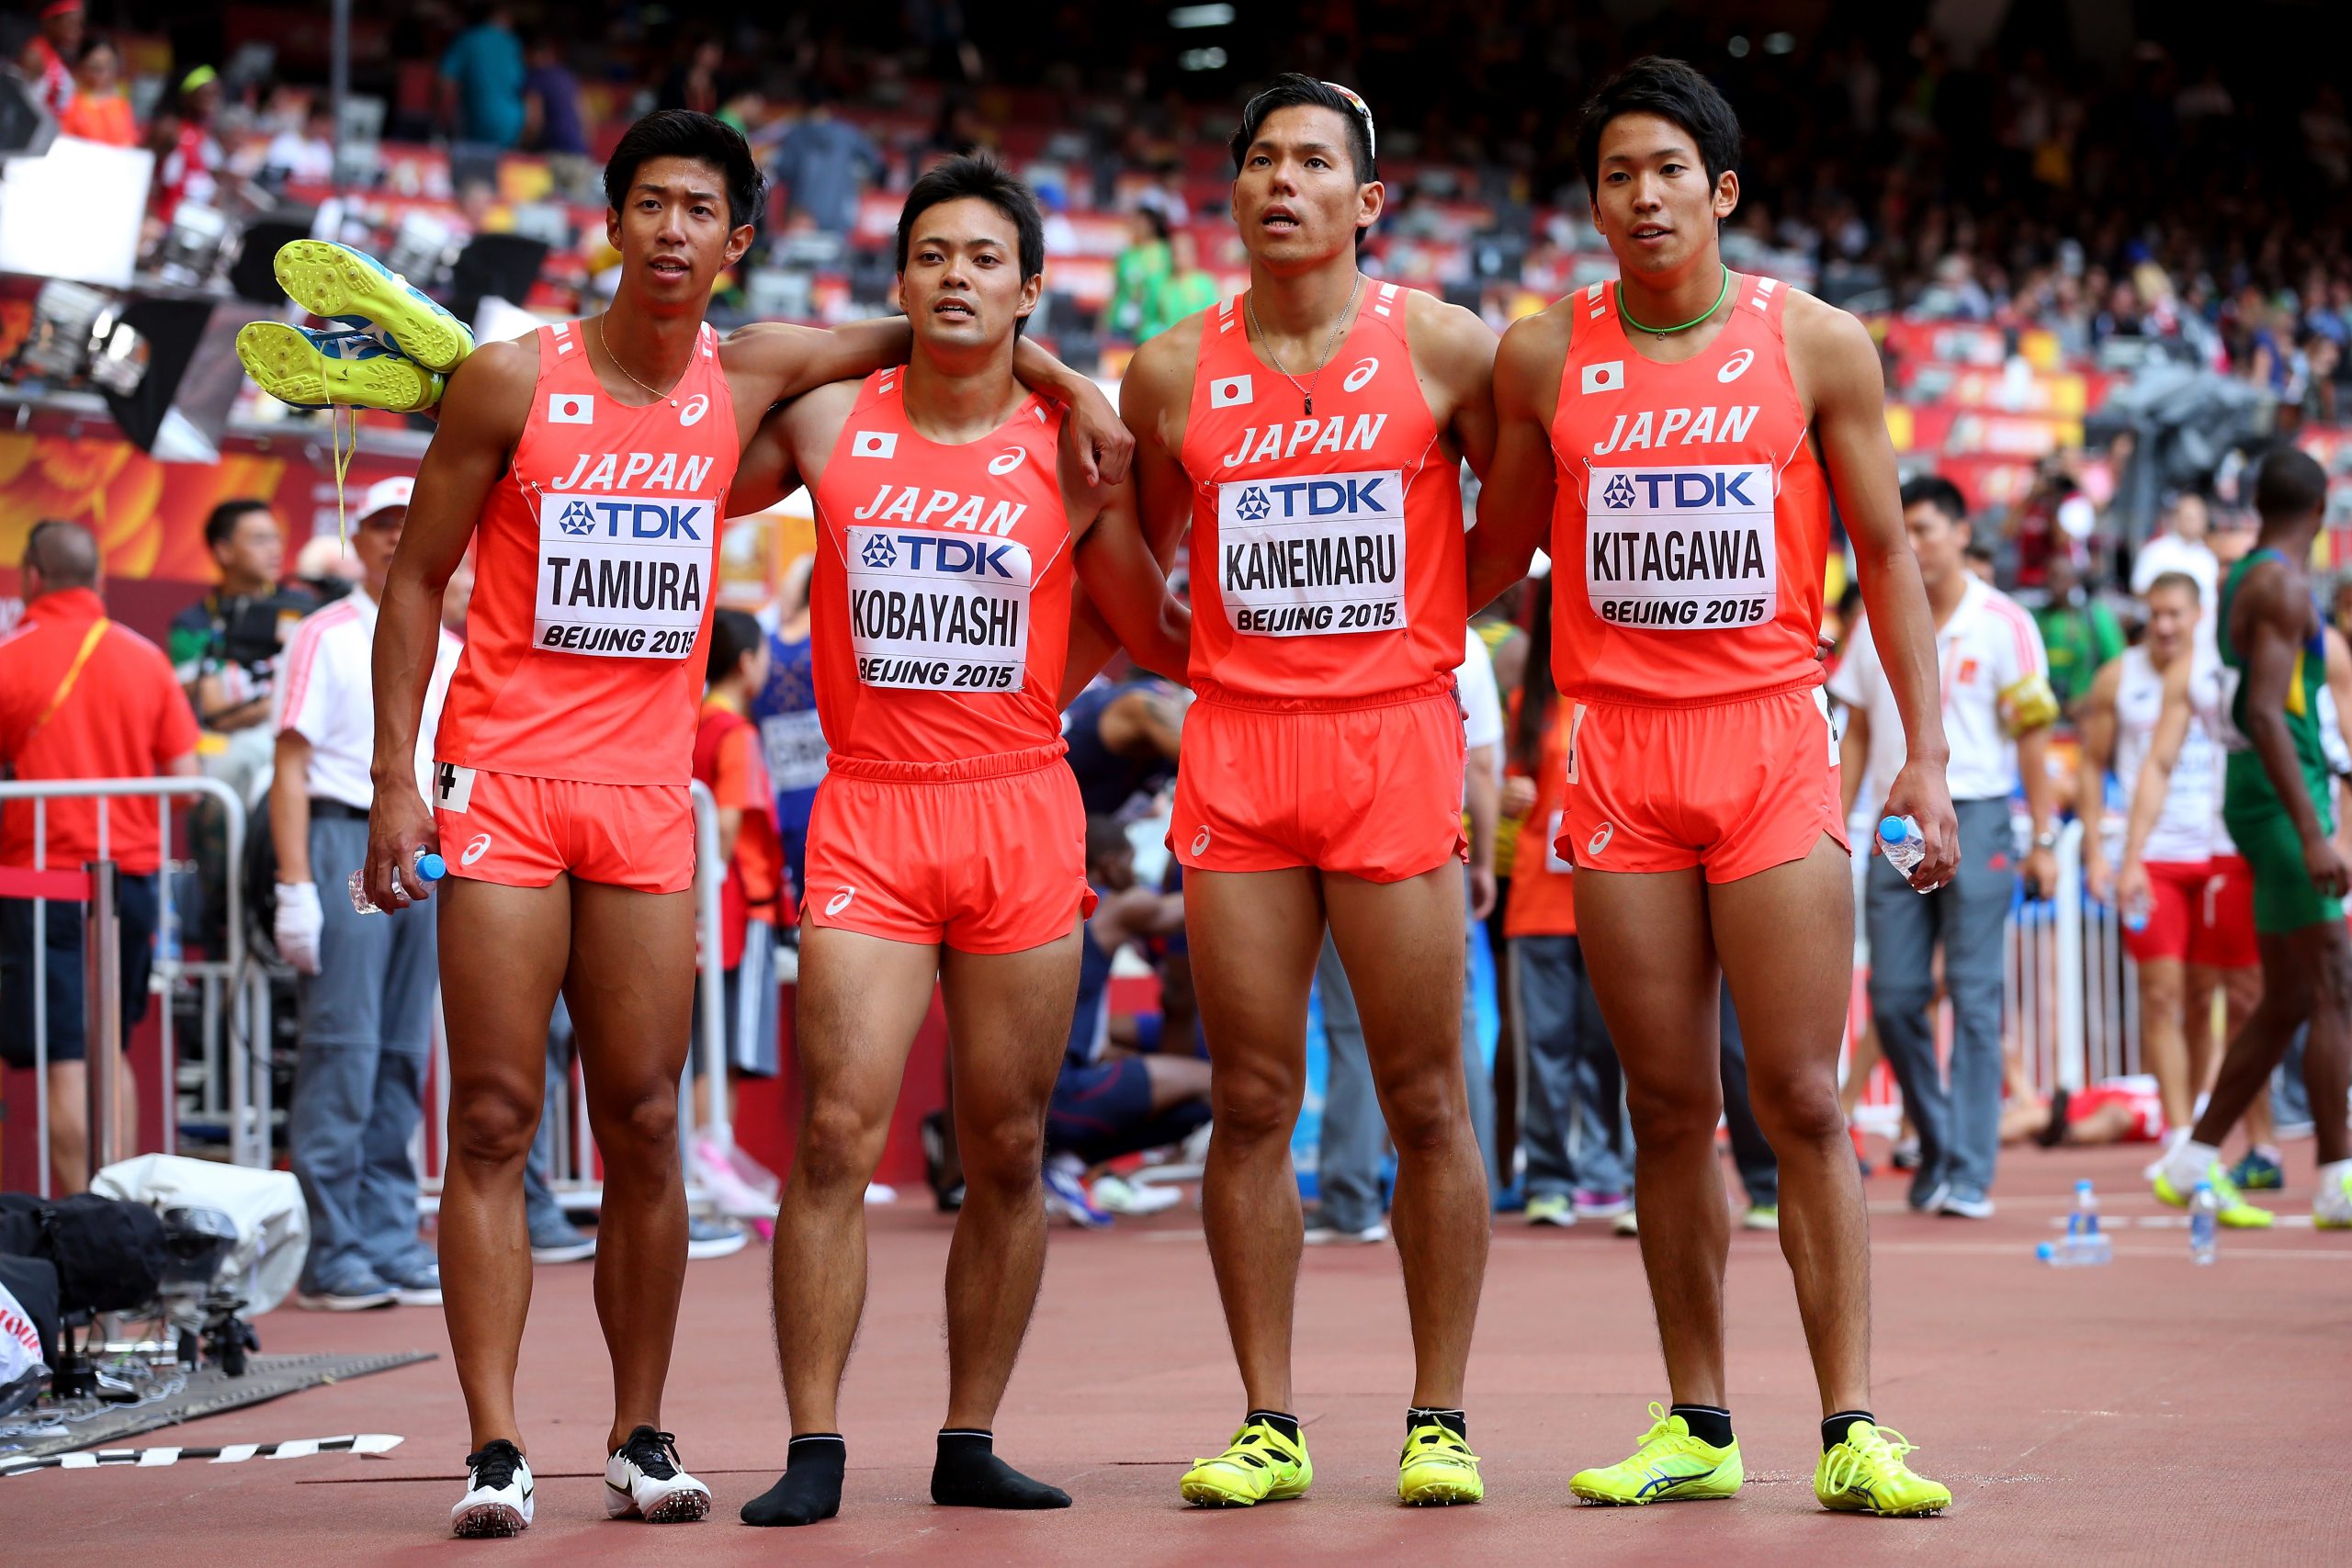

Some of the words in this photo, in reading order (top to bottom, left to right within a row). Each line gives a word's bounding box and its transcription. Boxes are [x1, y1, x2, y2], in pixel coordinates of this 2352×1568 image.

[1223, 413, 1388, 468] JAPAN
[1593, 405, 1761, 456] JAPAN
[551, 452, 715, 492] JAPAN
[1634, 471, 1757, 509] TDK
[854, 484, 1028, 536] JAPAN
[1270, 478, 1387, 518] TDK
[595, 502, 702, 541] TDK
[897, 536, 1014, 579] TDK
[1227, 534, 1396, 592] KANEMARU
[1592, 529, 1766, 581] KITAGAWA
[548, 557, 700, 612] TAMURA
[852, 589, 1019, 648] KOBAYASHI
[1238, 605, 1333, 632] BEIJING
[1339, 602, 1397, 628] 2015
[1601, 600, 1699, 625] BEIJING
[1703, 598, 1767, 624] 2015
[542, 625, 646, 652] BEIJING
[649, 630, 696, 654] 2015
[859, 657, 948, 685] BEIJING
[953, 664, 1015, 688] 2015
[439, 762, 457, 800] 4
